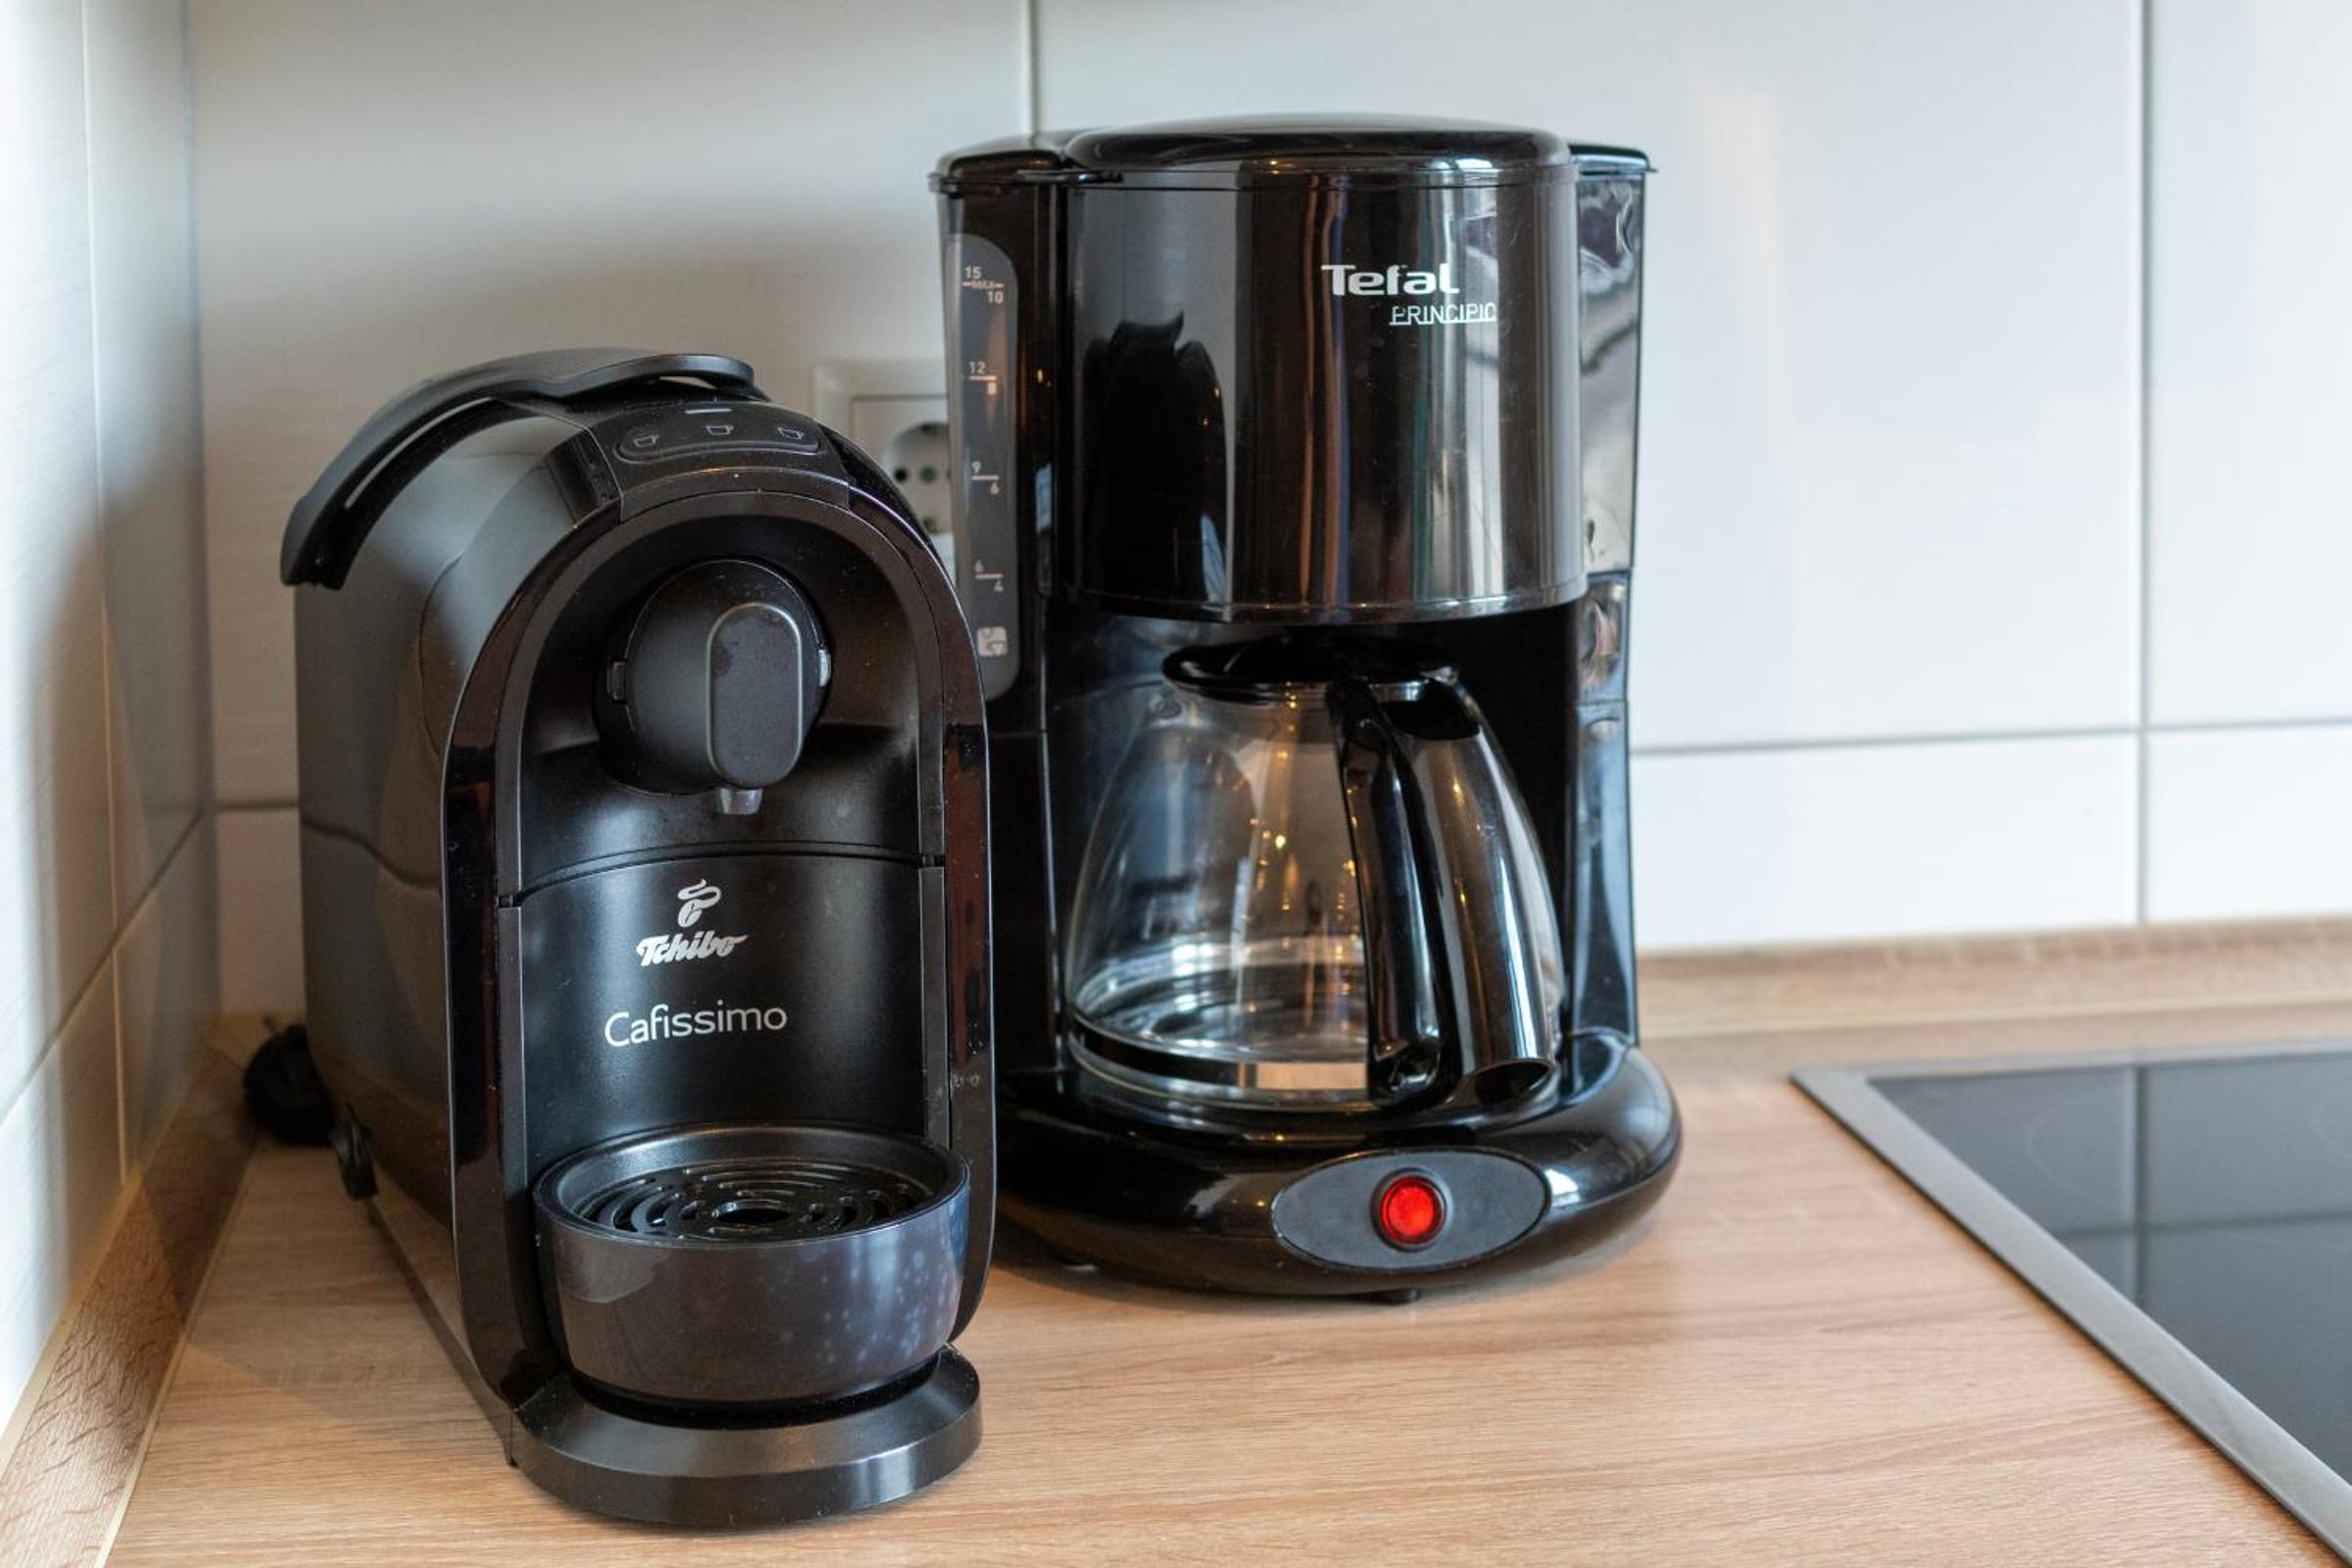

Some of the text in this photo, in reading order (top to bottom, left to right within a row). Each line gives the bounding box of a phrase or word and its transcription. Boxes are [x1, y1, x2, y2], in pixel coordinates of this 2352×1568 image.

[965, 266, 981, 279] 15
[1321, 263, 1460, 296] Tefal
[988, 291, 1004, 304] 10
[969, 362, 986, 374] 12
[987, 383, 997, 395] 8
[972, 461, 981, 473] 9
[991, 482, 1001, 495] 6
[636, 930, 750, 967] Tchibo
[604, 999, 788, 1048] Cafissimo
